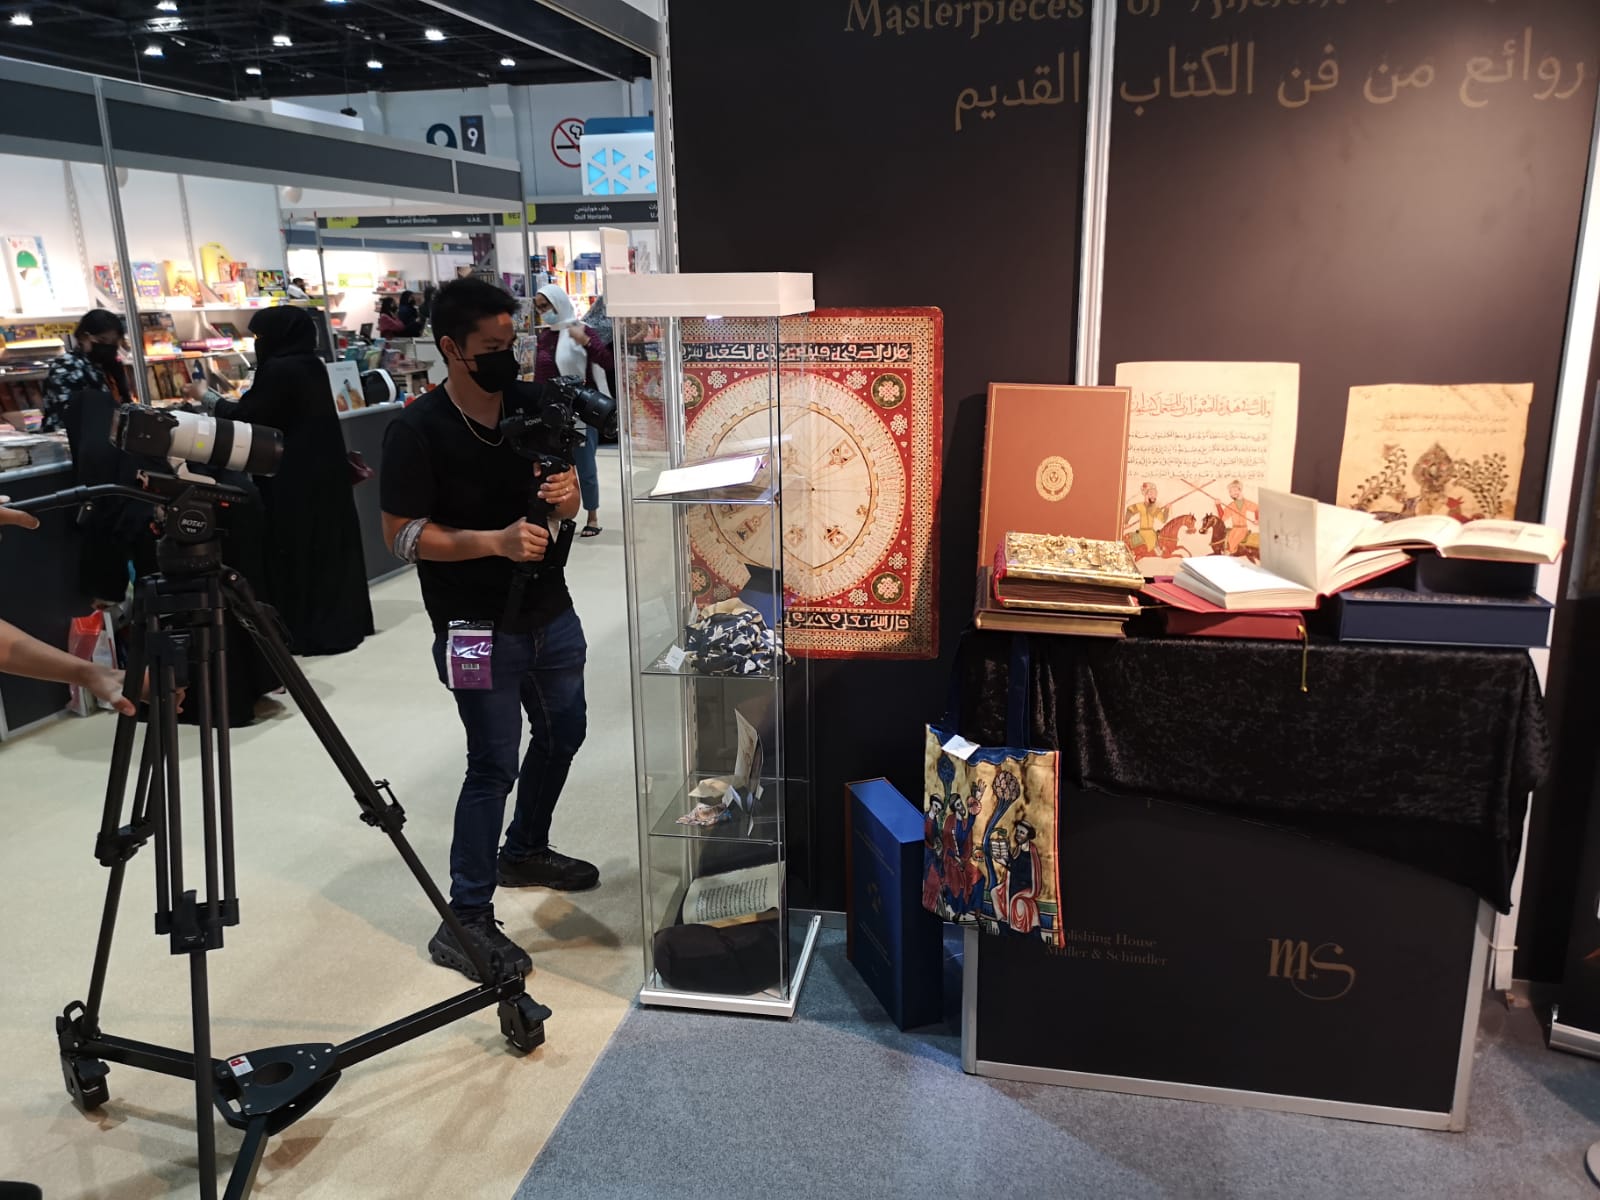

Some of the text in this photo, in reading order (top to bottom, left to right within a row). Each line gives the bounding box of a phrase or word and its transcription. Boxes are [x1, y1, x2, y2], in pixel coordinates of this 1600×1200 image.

[955, 26, 1585, 132] روائع من فن الكتاب القديم
[467, 127, 478, 148] 9
[1091, 948, 1102, 960] &
[1106, 949, 1169, 966] Schindler
